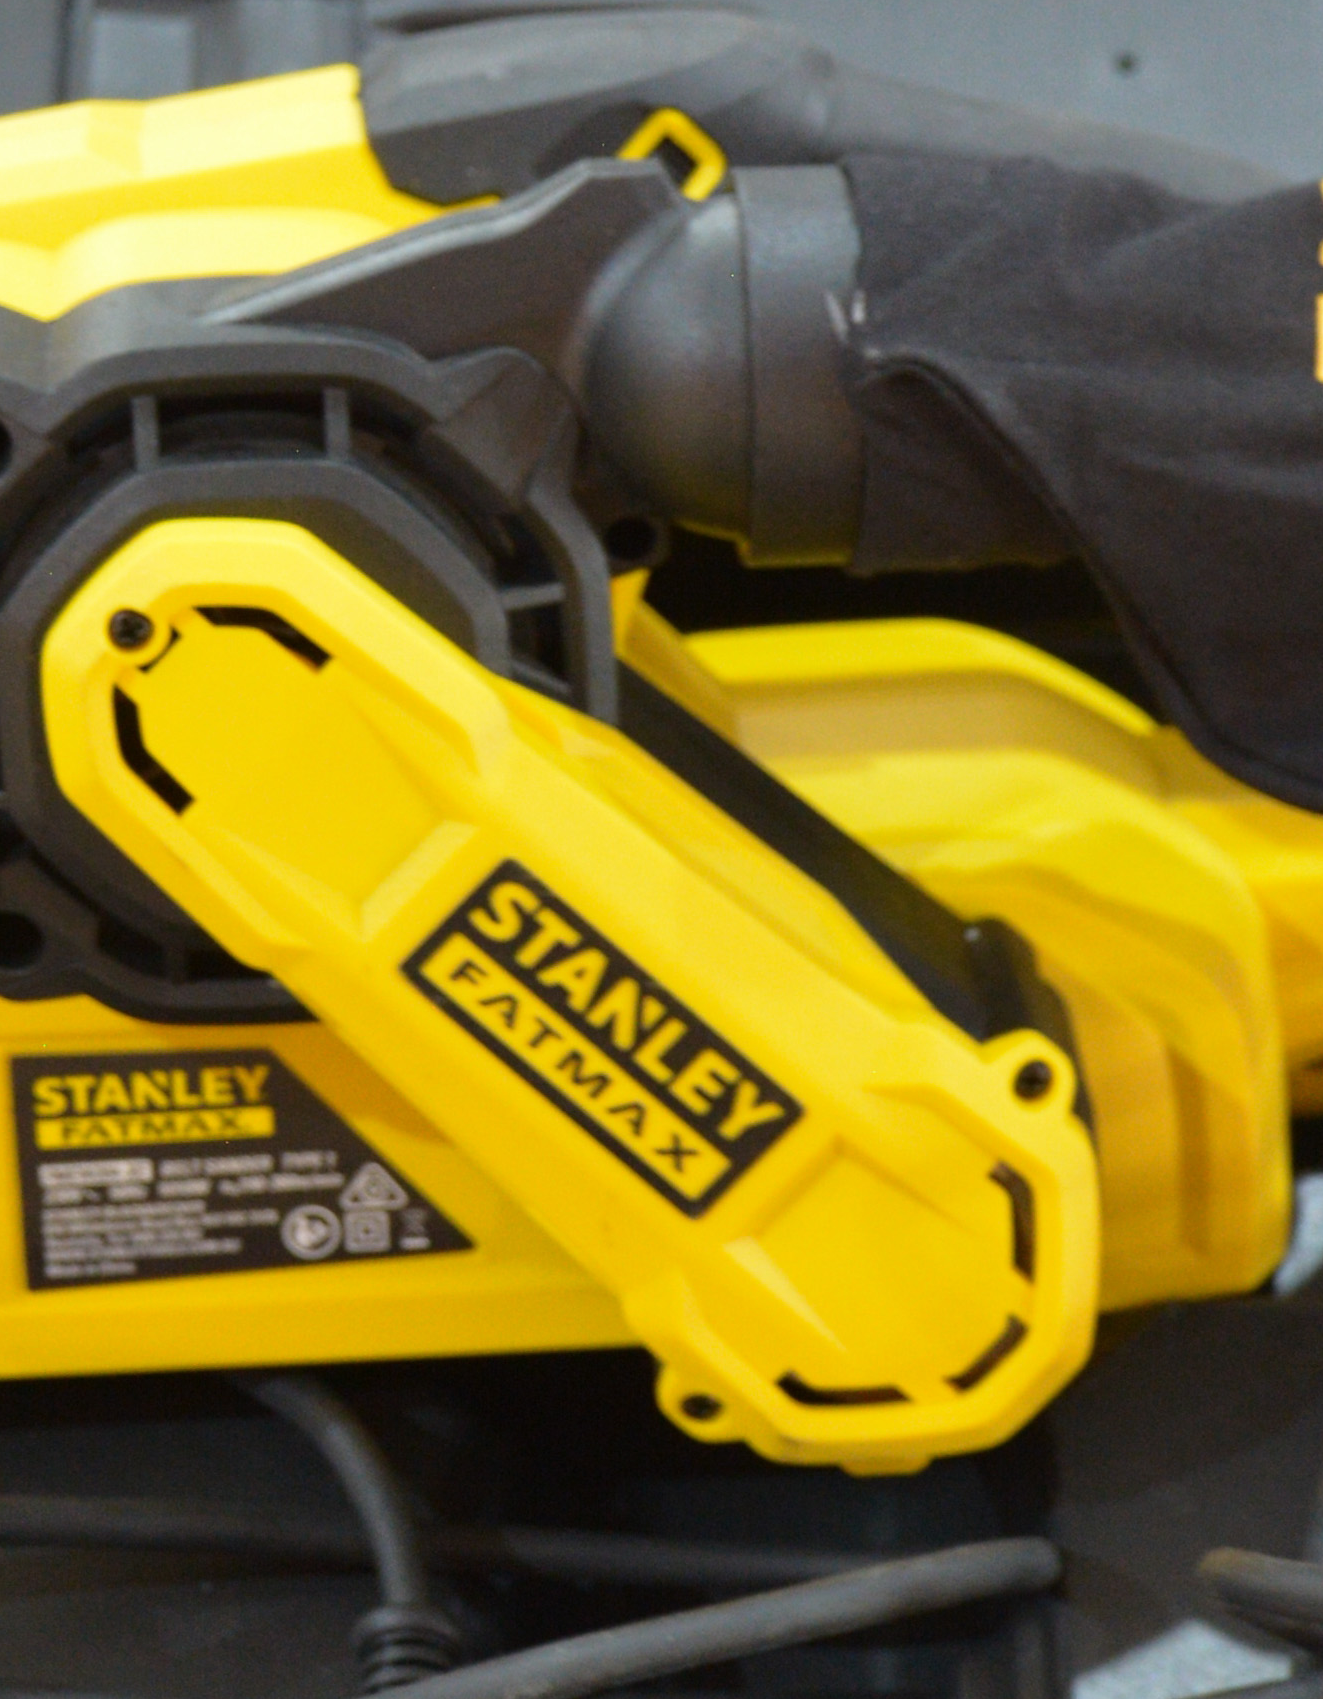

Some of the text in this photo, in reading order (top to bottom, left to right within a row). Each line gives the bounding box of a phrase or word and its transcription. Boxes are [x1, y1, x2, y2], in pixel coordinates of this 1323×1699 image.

[449, 958, 701, 1174] FATMAX
[467, 881, 785, 1145] STANLEY
[32, 1064, 270, 1118] STANLEY
[59, 1109, 240, 1145] FATMAX
